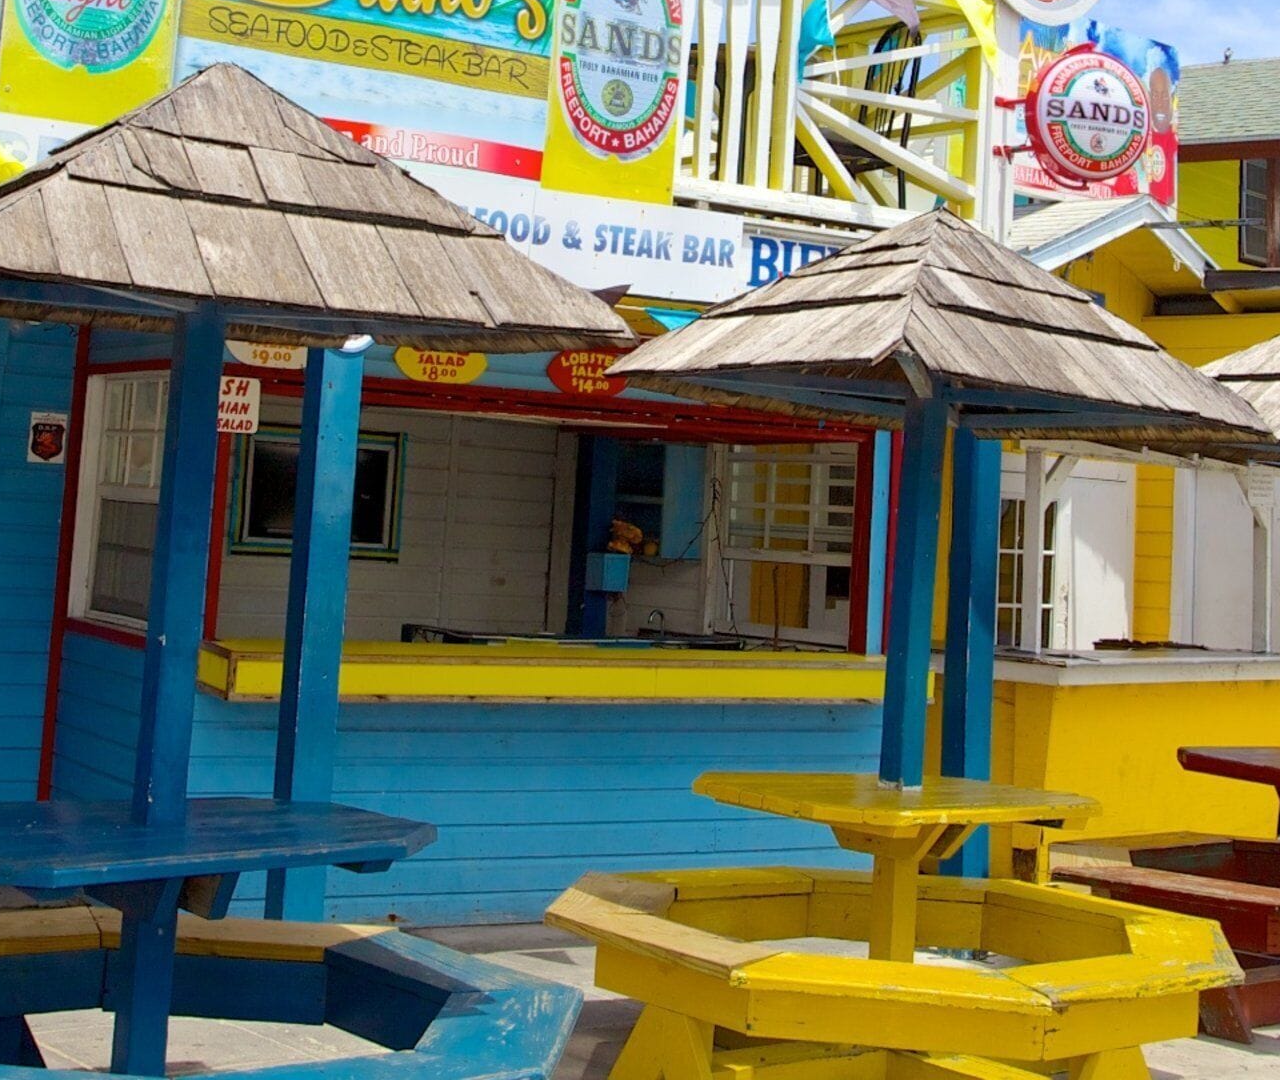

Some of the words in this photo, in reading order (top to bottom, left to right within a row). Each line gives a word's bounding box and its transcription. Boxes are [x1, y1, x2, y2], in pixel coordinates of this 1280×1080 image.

[560, 13, 683, 68] SANDS
[370, 35, 459, 74] STEAK
[460, 51, 530, 90] BAR
[562, 60, 611, 146] FREEPORT
[623, 81, 677, 149] BAHAMAS
[1045, 98, 1146, 130] SANDS
[361, 130, 406, 159] and
[411, 133, 481, 169] Proud
[1051, 124, 1095, 169] FREEPORT
[1100, 135, 1141, 171] BAHAMAS
[461, 204, 552, 246] FOOD
[562, 219, 582, 252] &
[594, 223, 675, 262] STEAK
[682, 235, 735, 269] BAR
[252, 349, 292, 364] $9.00
[417, 354, 466, 368] SALAD
[561, 352, 615, 368] LOBSTE
[422, 366, 457, 381] $8.00
[571, 365, 606, 380] SALA
[572, 377, 609, 394] $14.00
[216, 417, 253, 431] SALAD
